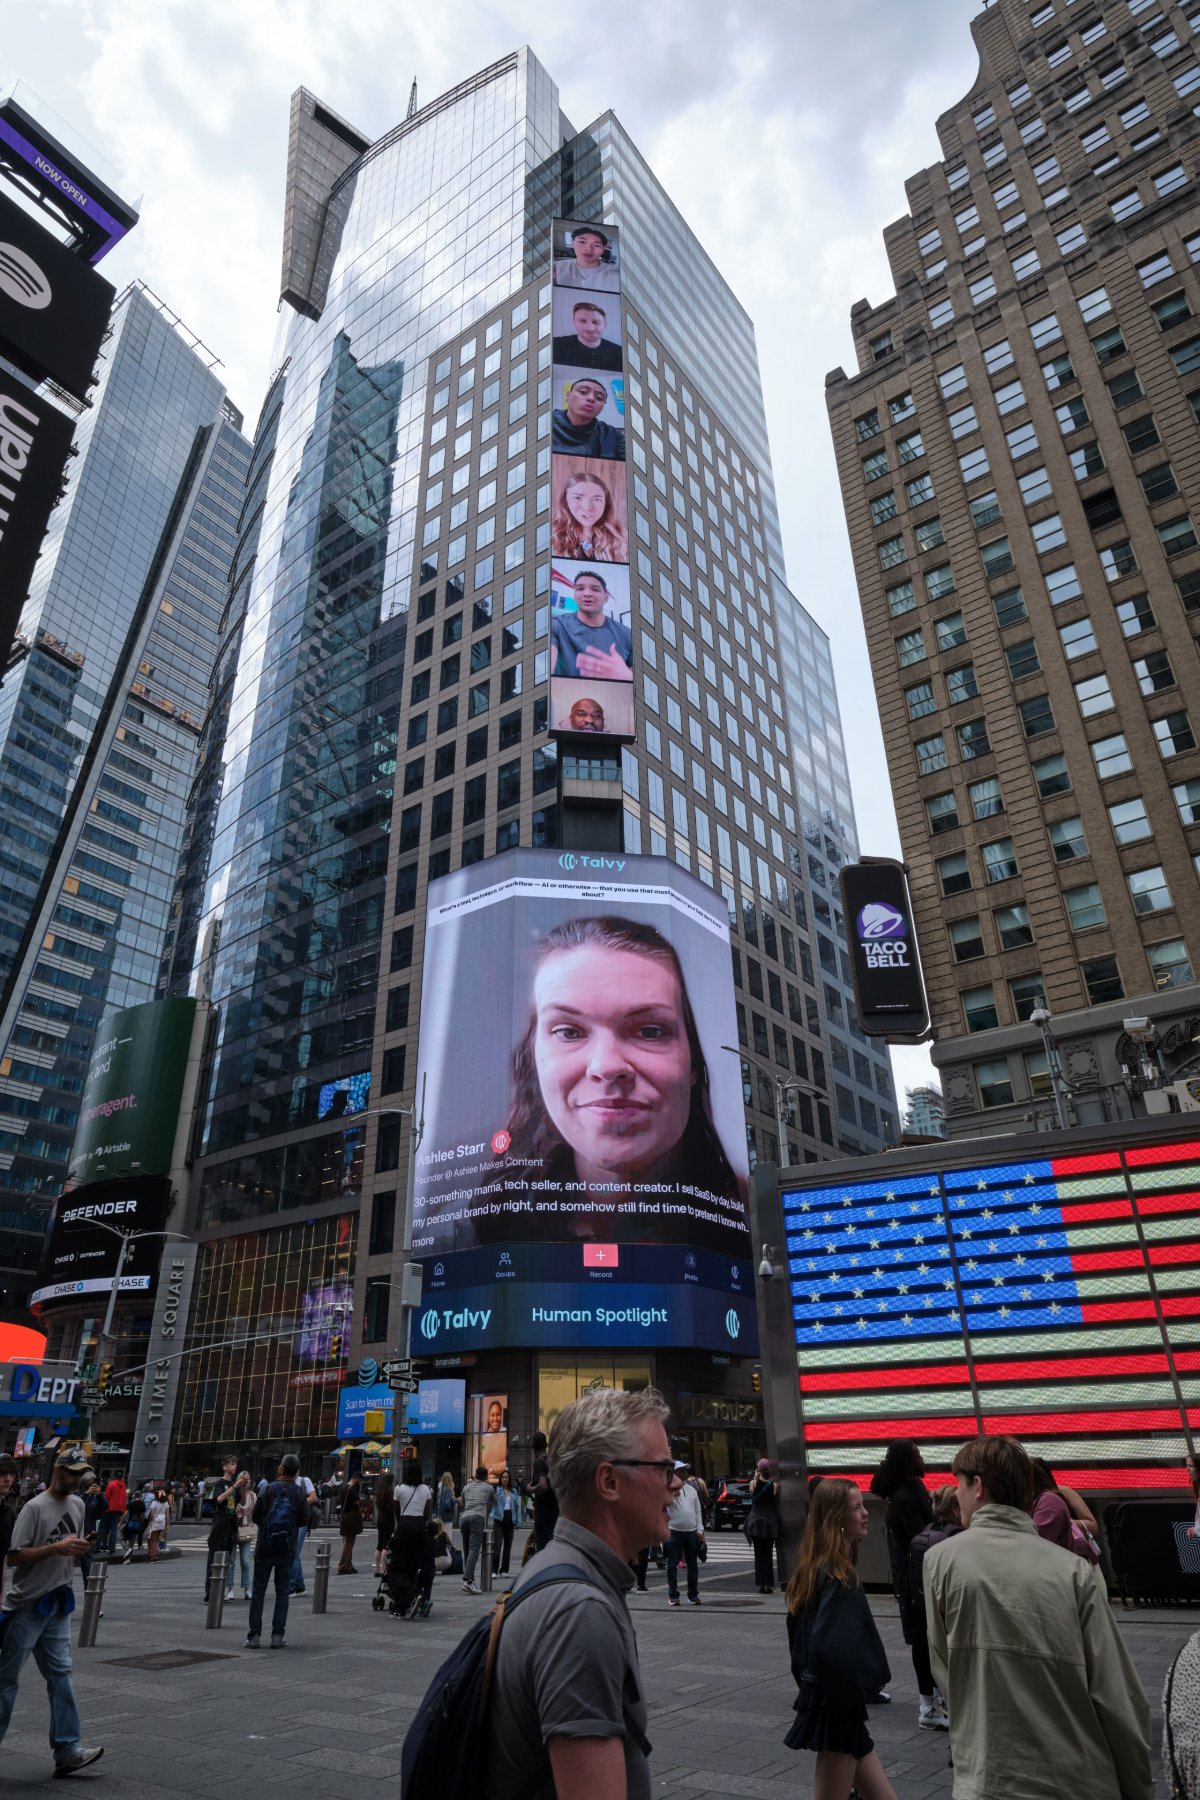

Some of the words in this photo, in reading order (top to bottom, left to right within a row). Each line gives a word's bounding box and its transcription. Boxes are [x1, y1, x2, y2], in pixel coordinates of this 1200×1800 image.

[35, 156, 62, 182] NOW
[61, 180, 88, 206] OPEN
[580, 855, 626, 872] Talvy
[505, 881, 534, 889] workflow
[861, 941, 907, 955] TACO
[867, 954, 911, 969] BELL
[94, 1056, 112, 1078] and
[104, 1142, 131, 1154] Airtable
[416, 1150, 454, 1167] Ashlee
[456, 1142, 486, 1158] Starr
[415, 1172, 443, 1185] Founder
[444, 1170, 453, 1180] @
[453, 1165, 478, 1178] Ashlee
[480, 1160, 504, 1172] Makes
[505, 1156, 544, 1167] Content
[414, 1188, 473, 1208] 30-something
[474, 1183, 503, 1196] mama,
[504, 1179, 529, 1190] tech
[531, 1180, 563, 1192] seller,
[564, 1180, 587, 1191] and
[589, 1182, 631, 1192] content
[634, 1183, 675, 1193] creator.
[681, 1184, 694, 1196] sell
[694, 1186, 710, 1200] SaaS
[710, 1192, 719, 1205] by
[719, 1195, 730, 1209] day,
[731, 1198, 745, 1213] build
[62, 1200, 138, 1223] DEFENDER
[412, 1218, 426, 1229] my
[426, 1208, 462, 1227] personal
[463, 1204, 489, 1218] brand
[490, 1203, 501, 1214] by
[503, 1200, 534, 1213] night,
[535, 1200, 558, 1211] and
[560, 1201, 615, 1212] somehow
[617, 1202, 636, 1213] still
[638, 1202, 660, 1213] find
[662, 1203, 687, 1214] time
[687, 1204, 695, 1215] to
[695, 1208, 718, 1223] pretend
[720, 1214, 737, 1229] know
[412, 1236, 434, 1248] more
[54, 1256, 70, 1265] CHASE
[79, 1250, 106, 1259] DEFENDER
[495, 1271, 516, 1279] Groups
[54, 1283, 76, 1295] CHASE
[431, 1280, 446, 1288] Home
[161, 1257, 186, 1338] SQUARE
[443, 1307, 492, 1330] Talvy
[532, 1307, 592, 1322] Human
[596, 1307, 668, 1327] Spotlight
[435, 1357, 460, 1366] branded
[10, 1364, 80, 1403] DEPT
[148, 1359, 170, 1421] TIMES
[345, 1399, 358, 1410] Scan
[358, 1399, 366, 1408] to
[366, 1396, 383, 1407] learn
[145, 1433, 160, 1447] 3
